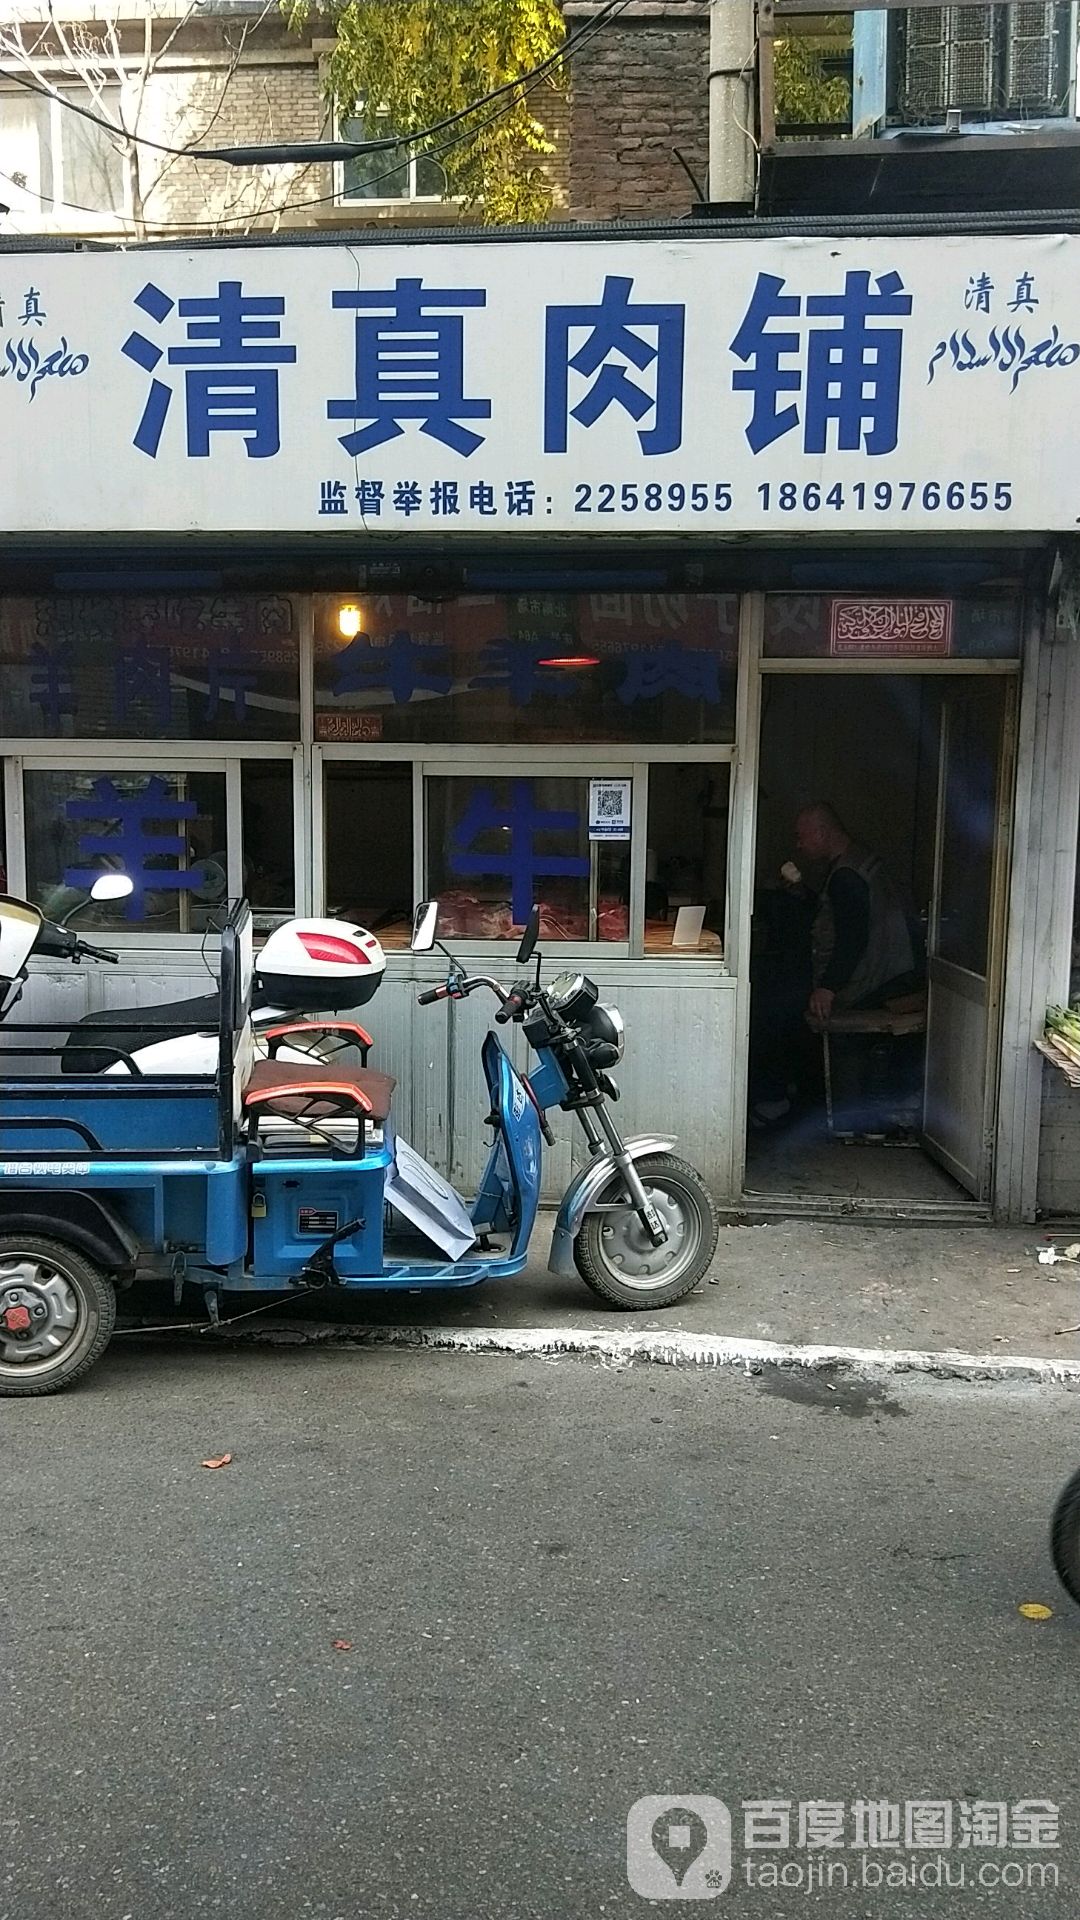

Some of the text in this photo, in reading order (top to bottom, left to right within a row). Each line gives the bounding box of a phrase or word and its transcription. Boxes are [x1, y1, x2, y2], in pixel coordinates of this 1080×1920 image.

[120, 270, 913, 459] 清真肉铺
[964, 271, 1039, 314] 清真
[574, 482, 733, 513] 2258955
[756, 481, 1013, 511] 18641976655
[63, 774, 206, 923] 羊
[449, 779, 591, 926] 牛
